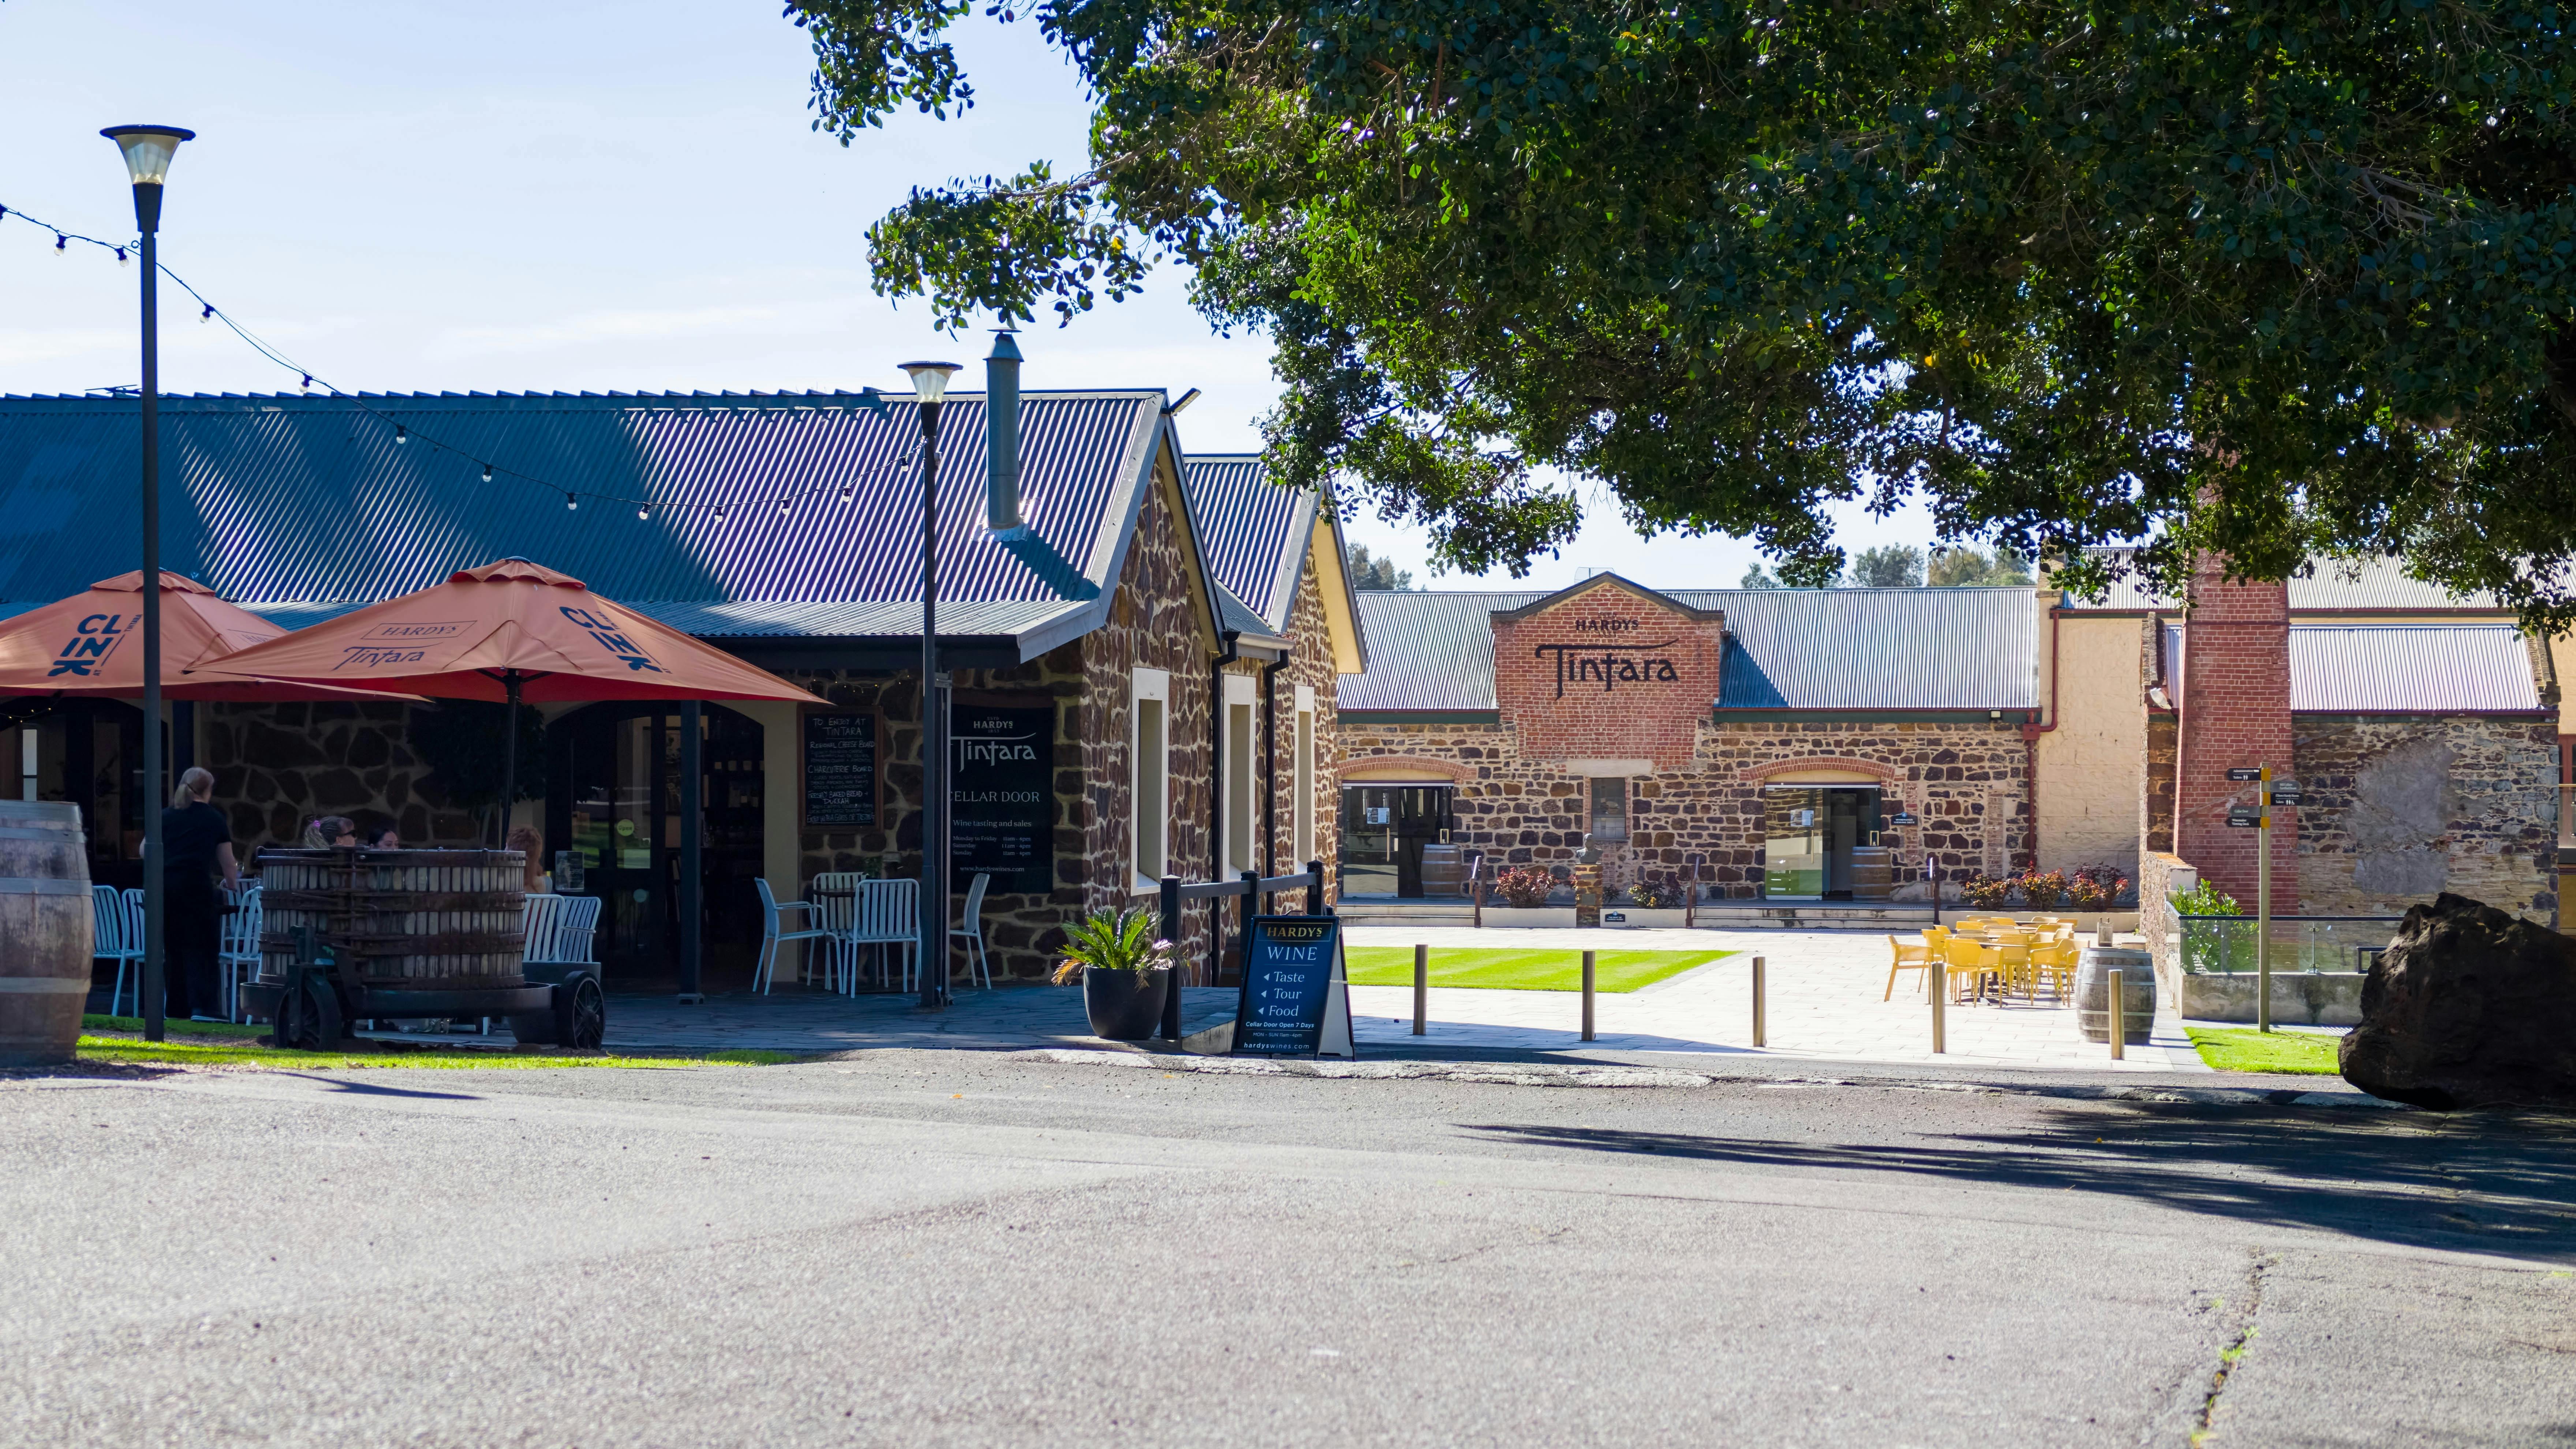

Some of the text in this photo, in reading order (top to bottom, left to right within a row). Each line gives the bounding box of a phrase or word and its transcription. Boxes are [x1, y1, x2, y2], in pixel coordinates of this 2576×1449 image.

[381, 625, 459, 636] HARDYS
[330, 642, 443, 671] Tintara
[1535, 638, 1680, 702] Tintara
[812, 718, 823, 727] TO
[855, 718, 866, 726] AT
[822, 727, 862, 736] TINTARA
[950, 732, 1036, 772] Tintara
[950, 791, 1040, 802] ELLAR DOOR
[973, 820, 998, 828] tasting
[1267, 927, 1322, 937] HARDYS
[1267, 946, 1317, 960] WINE
[1274, 971, 1305, 982] Taste
[1274, 988, 1302, 999] Tour
[1269, 1005, 1299, 1016] Food
